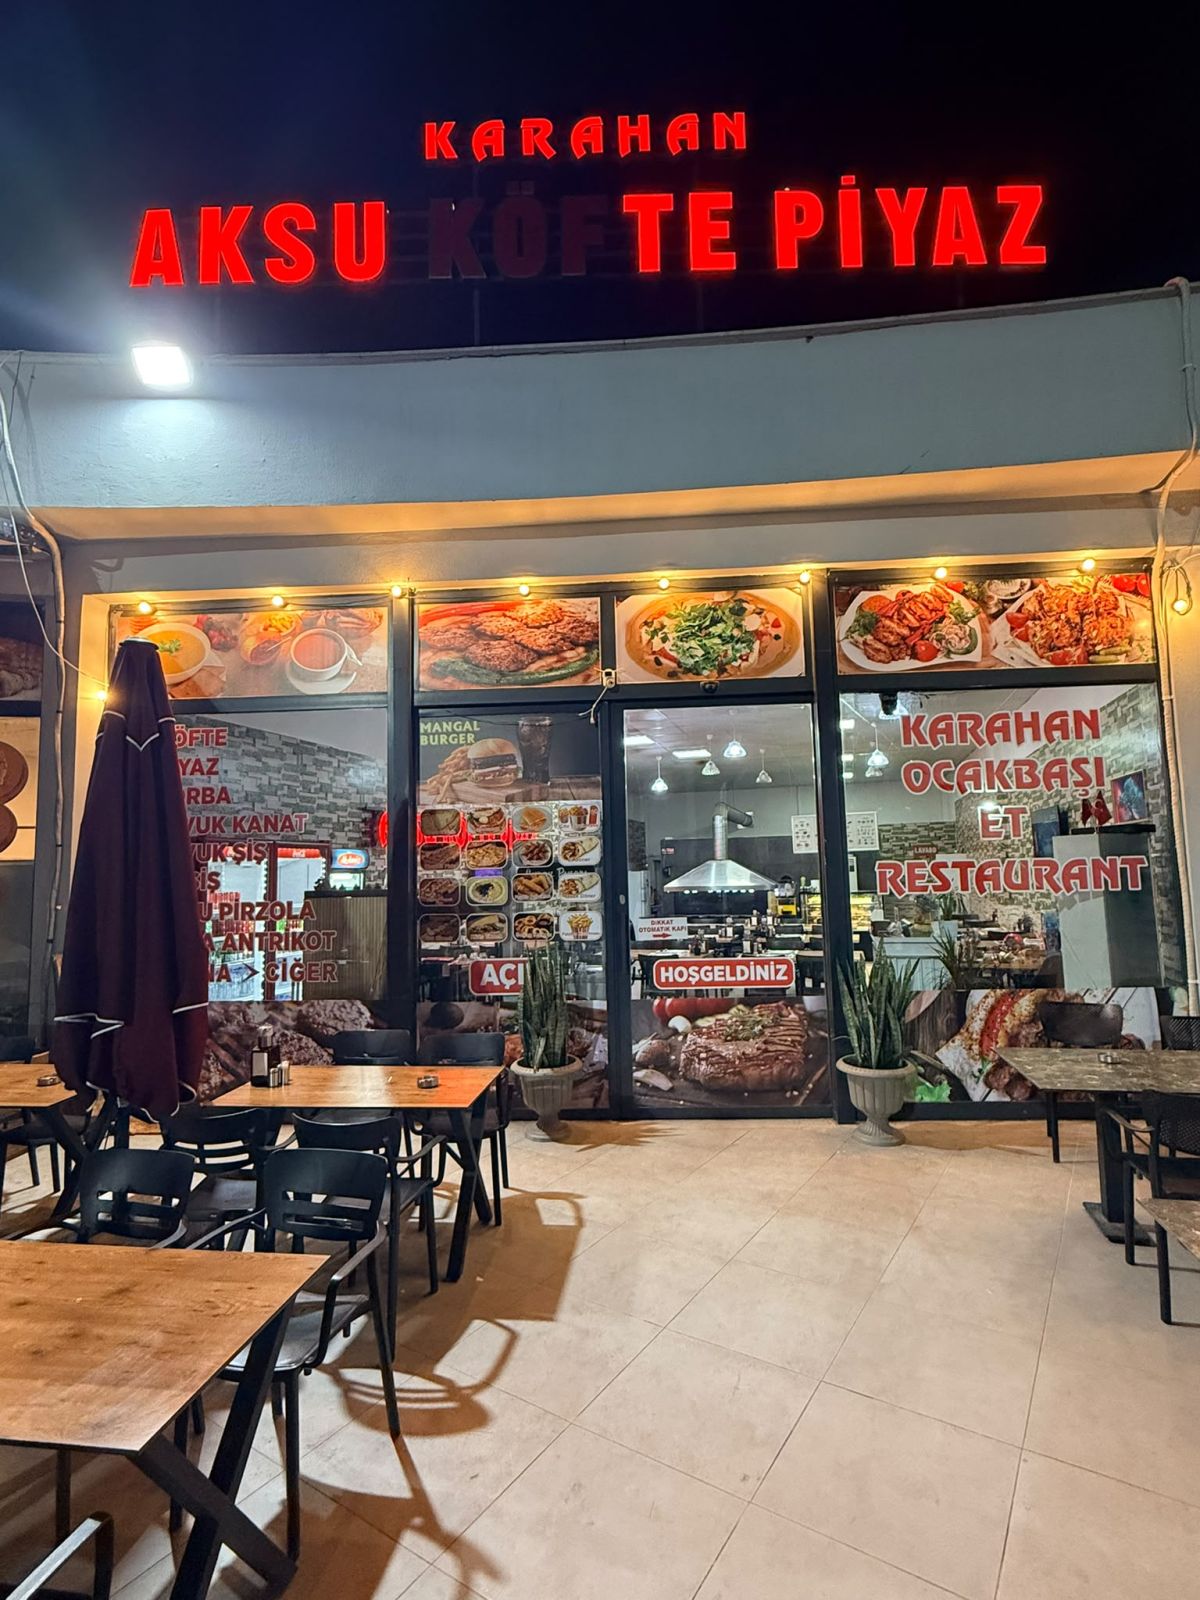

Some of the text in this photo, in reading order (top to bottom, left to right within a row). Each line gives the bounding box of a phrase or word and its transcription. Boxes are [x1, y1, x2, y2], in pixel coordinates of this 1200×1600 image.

[424, 111, 747, 162] KARAHAN
[129, 175, 1048, 287] AKSU KÖFTE PİYAZ
[174, 724, 228, 748] ÖFTE
[420, 720, 480, 733] MANGAL
[901, 708, 1101, 749] KARAHAN
[420, 733, 476, 745] BURGER
[177, 757, 220, 776] YAZ
[902, 756, 1106, 798] OCAKBAŞI
[183, 786, 232, 805] RBA
[232, 813, 309, 833] KANAT
[979, 805, 1030, 840] ET
[232, 840, 269, 865] ŞİŞ
[874, 856, 1149, 898] RESTAURANT
[218, 898, 317, 921] PİRZOLA
[221, 930, 337, 952] ANTRİKOT
[264, 957, 338, 984] CİĞER
[480, 963, 529, 990] AÇI
[660, 961, 789, 985] HOŞGELDİNİZ
